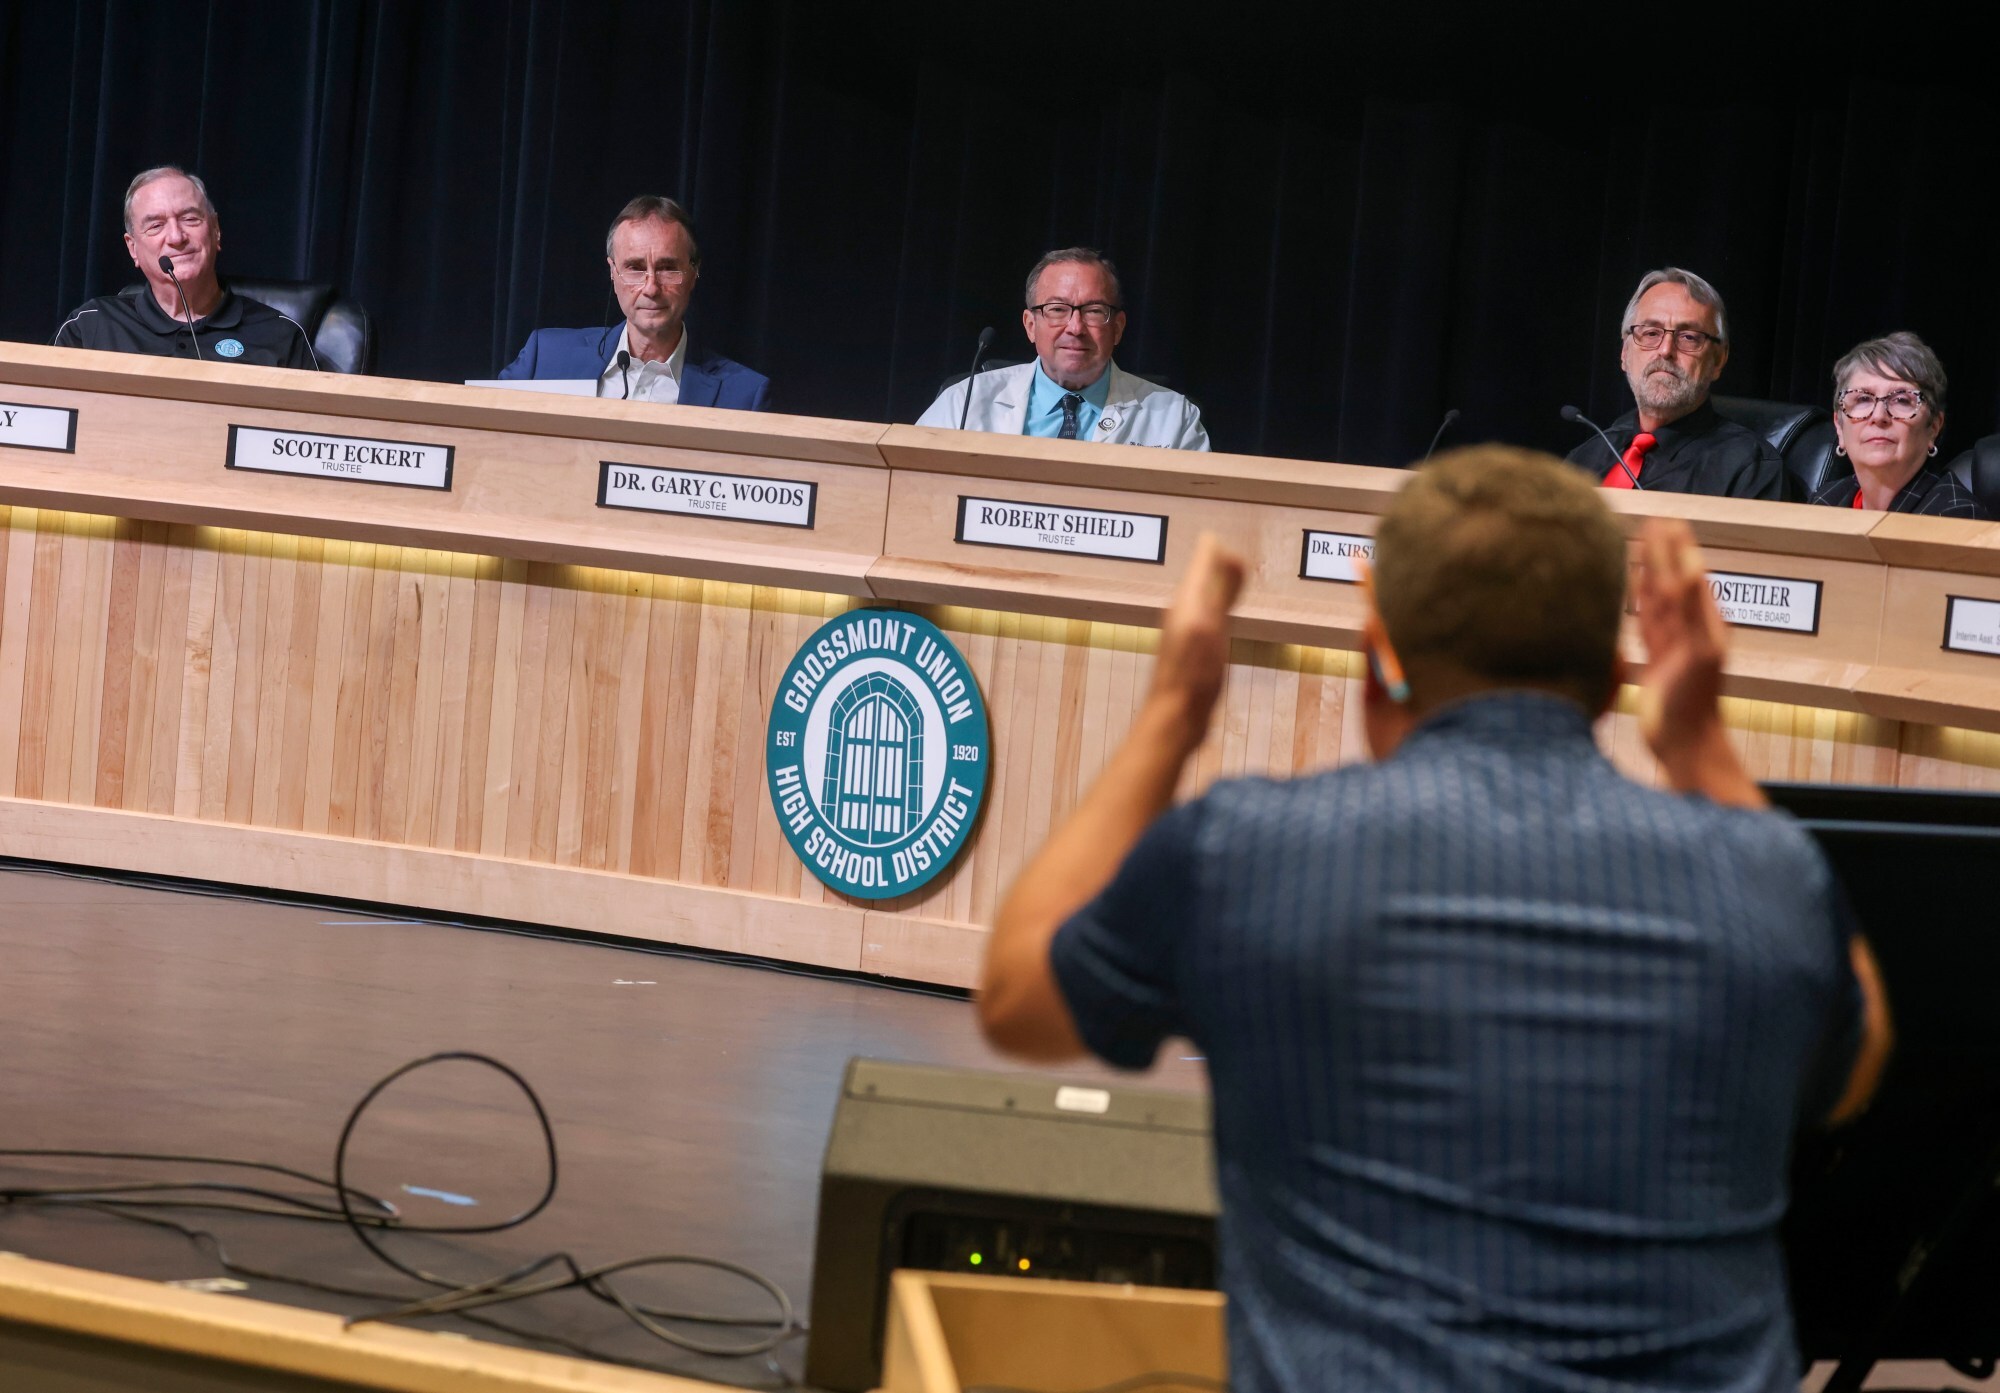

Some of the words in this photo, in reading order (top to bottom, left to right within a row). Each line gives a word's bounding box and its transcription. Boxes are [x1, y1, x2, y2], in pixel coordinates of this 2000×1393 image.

[0, 410, 18, 427] Y
[272, 438, 339, 461] SCOTT
[343, 444, 425, 469] ECKERT
[321, 461, 362, 474] TRUSTEE
[613, 472, 645, 491] DR.
[651, 475, 707, 497] GARY
[709, 481, 726, 499] C.
[732, 483, 804, 507] WOODS
[688, 498, 727, 512] TRUSTEE
[980, 506, 1059, 531] ROBERT
[1062, 514, 1134, 539] SHIELD
[1038, 533, 1075, 546] TRUSTEE
[1311, 539, 1333, 555] DR.
[1706, 579, 1790, 607] OSTETLER
[1720, 606, 1736, 619] ERK
[1738, 608, 1747, 619] TO
[1750, 609, 1763, 621] THE
[1765, 611, 1790, 624] BOARD
[784, 617, 916, 714] GROSSMONT
[914, 636, 973, 724] UNION
[776, 731, 796, 747] EST
[952, 744, 979, 762] 1920
[775, 765, 814, 835] HIGH
[804, 826, 888, 887] SCHOOL
[892, 777, 973, 884] DISTRICT
